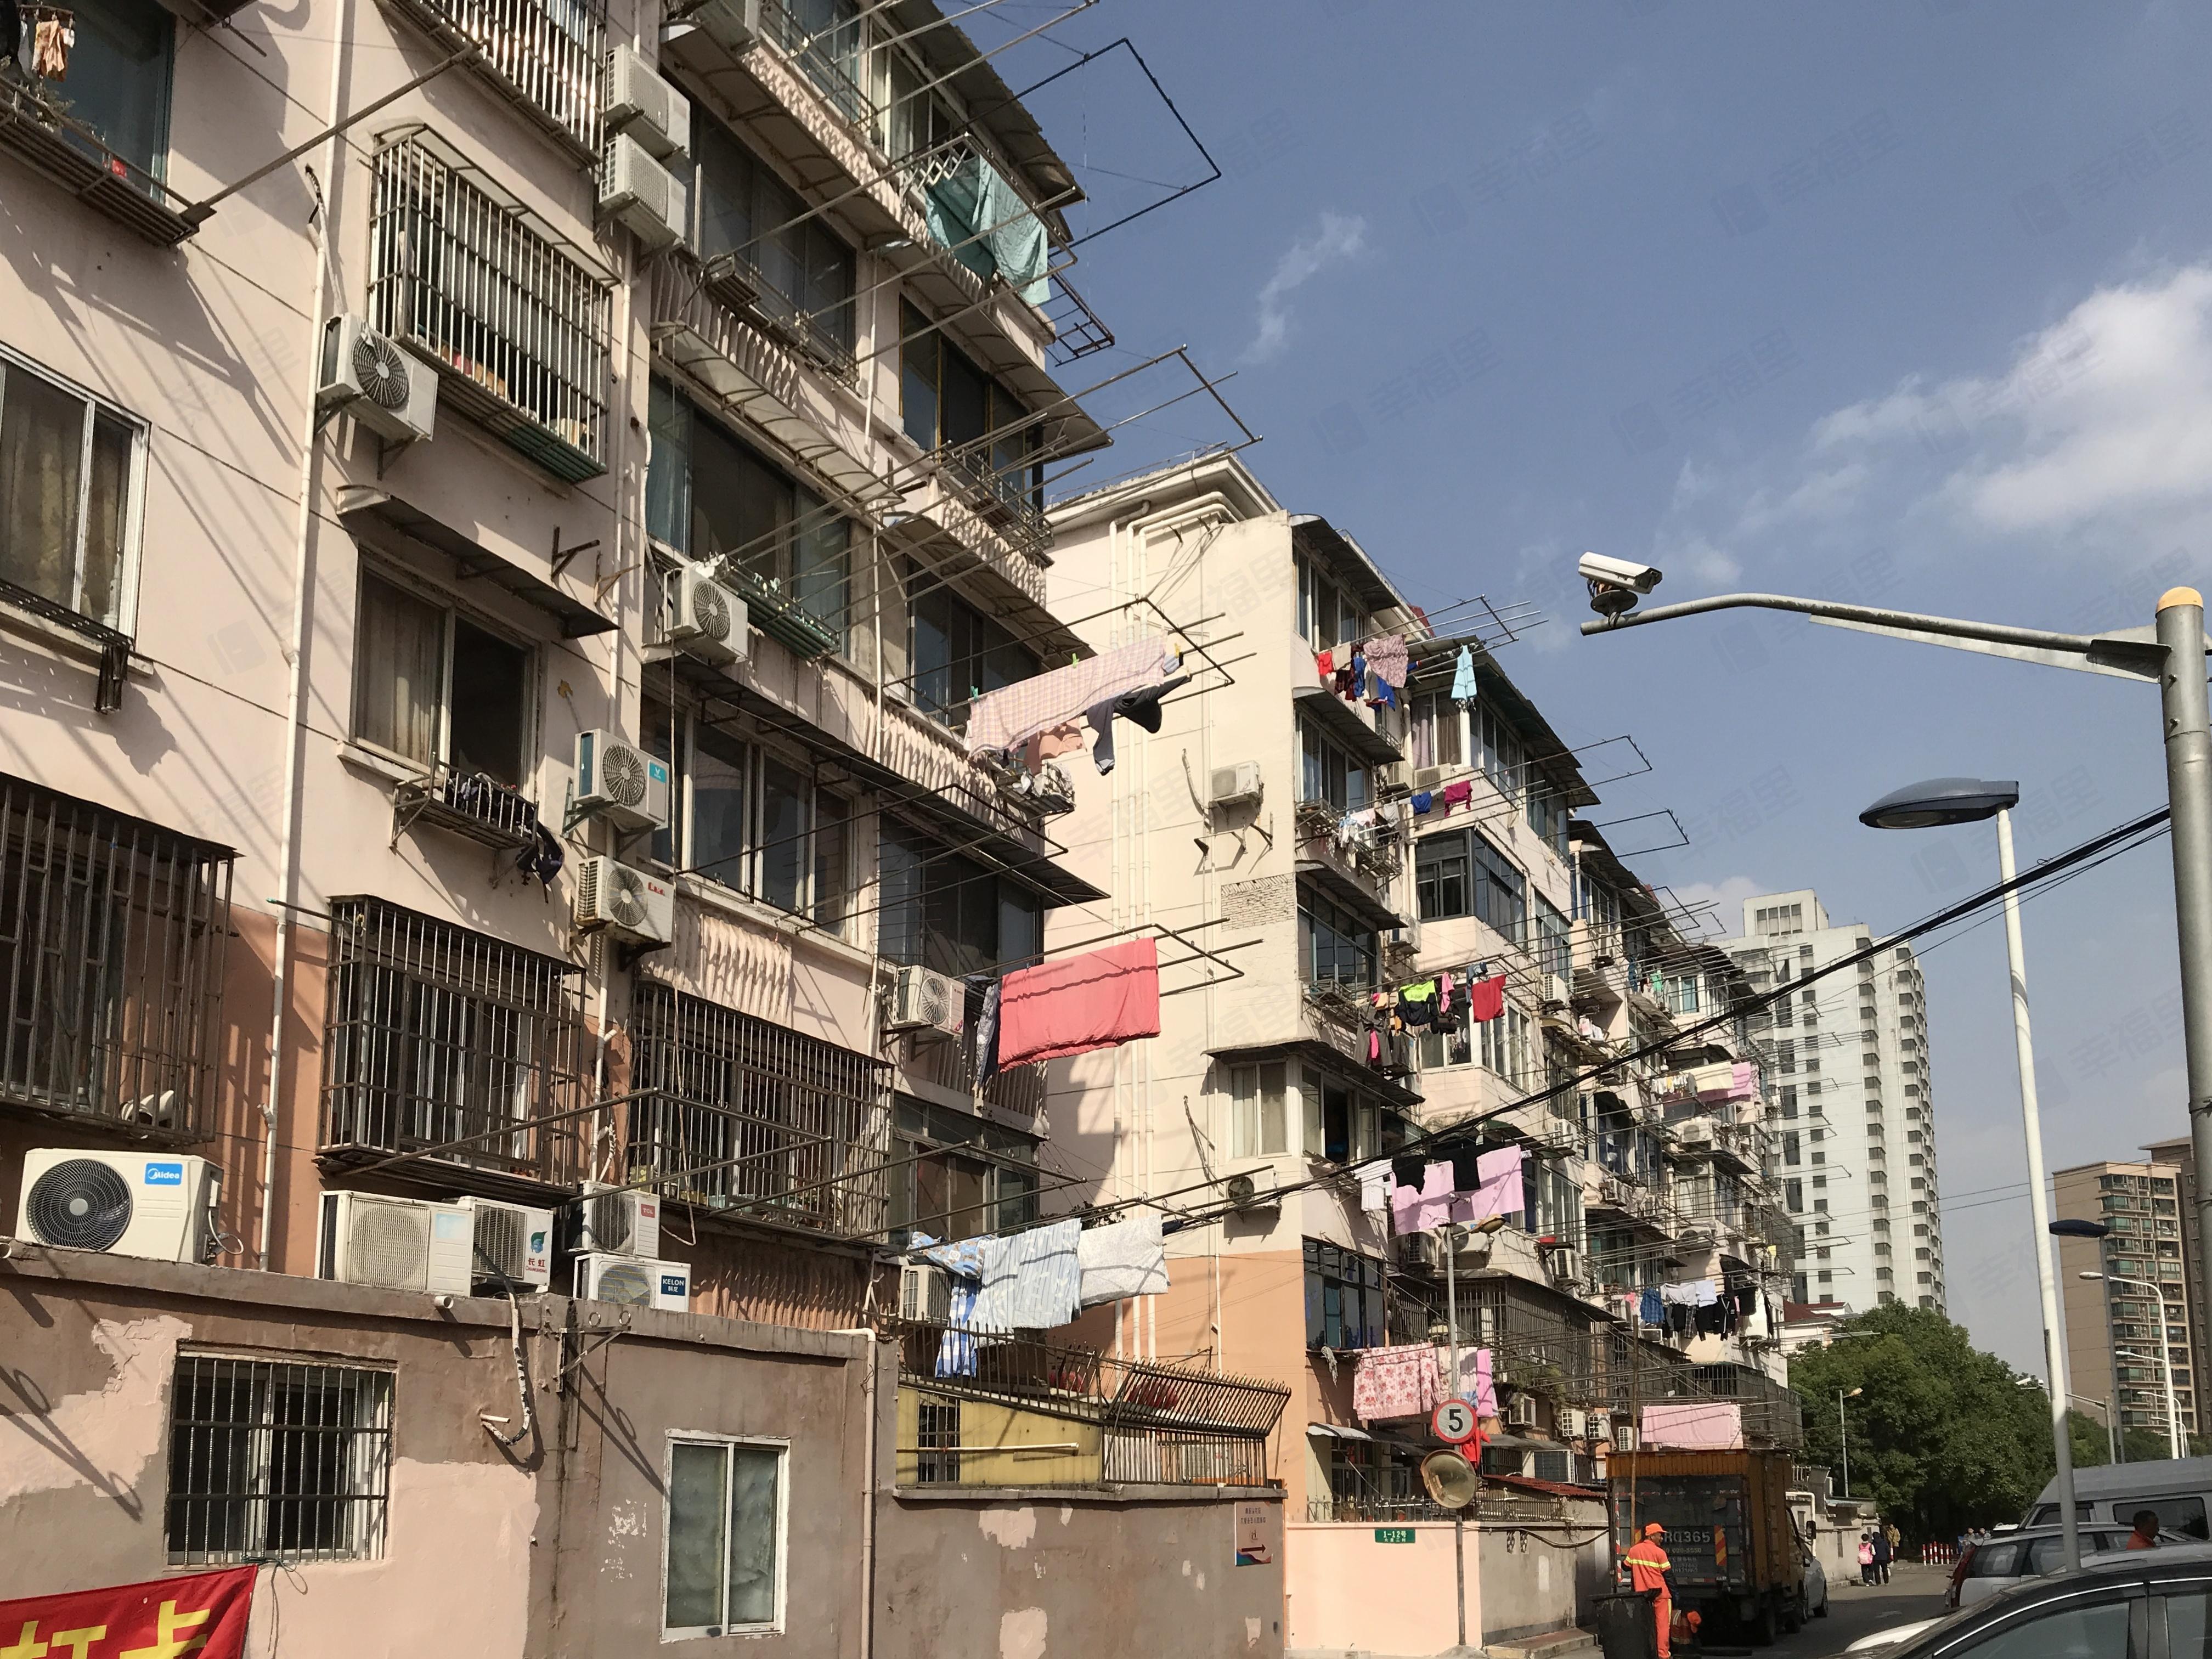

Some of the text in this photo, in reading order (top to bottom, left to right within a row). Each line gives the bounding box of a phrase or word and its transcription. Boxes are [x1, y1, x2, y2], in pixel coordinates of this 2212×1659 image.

[148, 1167, 180, 1180] Midea
[1448, 1408, 1463, 1432] 5
[1383, 1530, 1407, 1538] 1-12号
